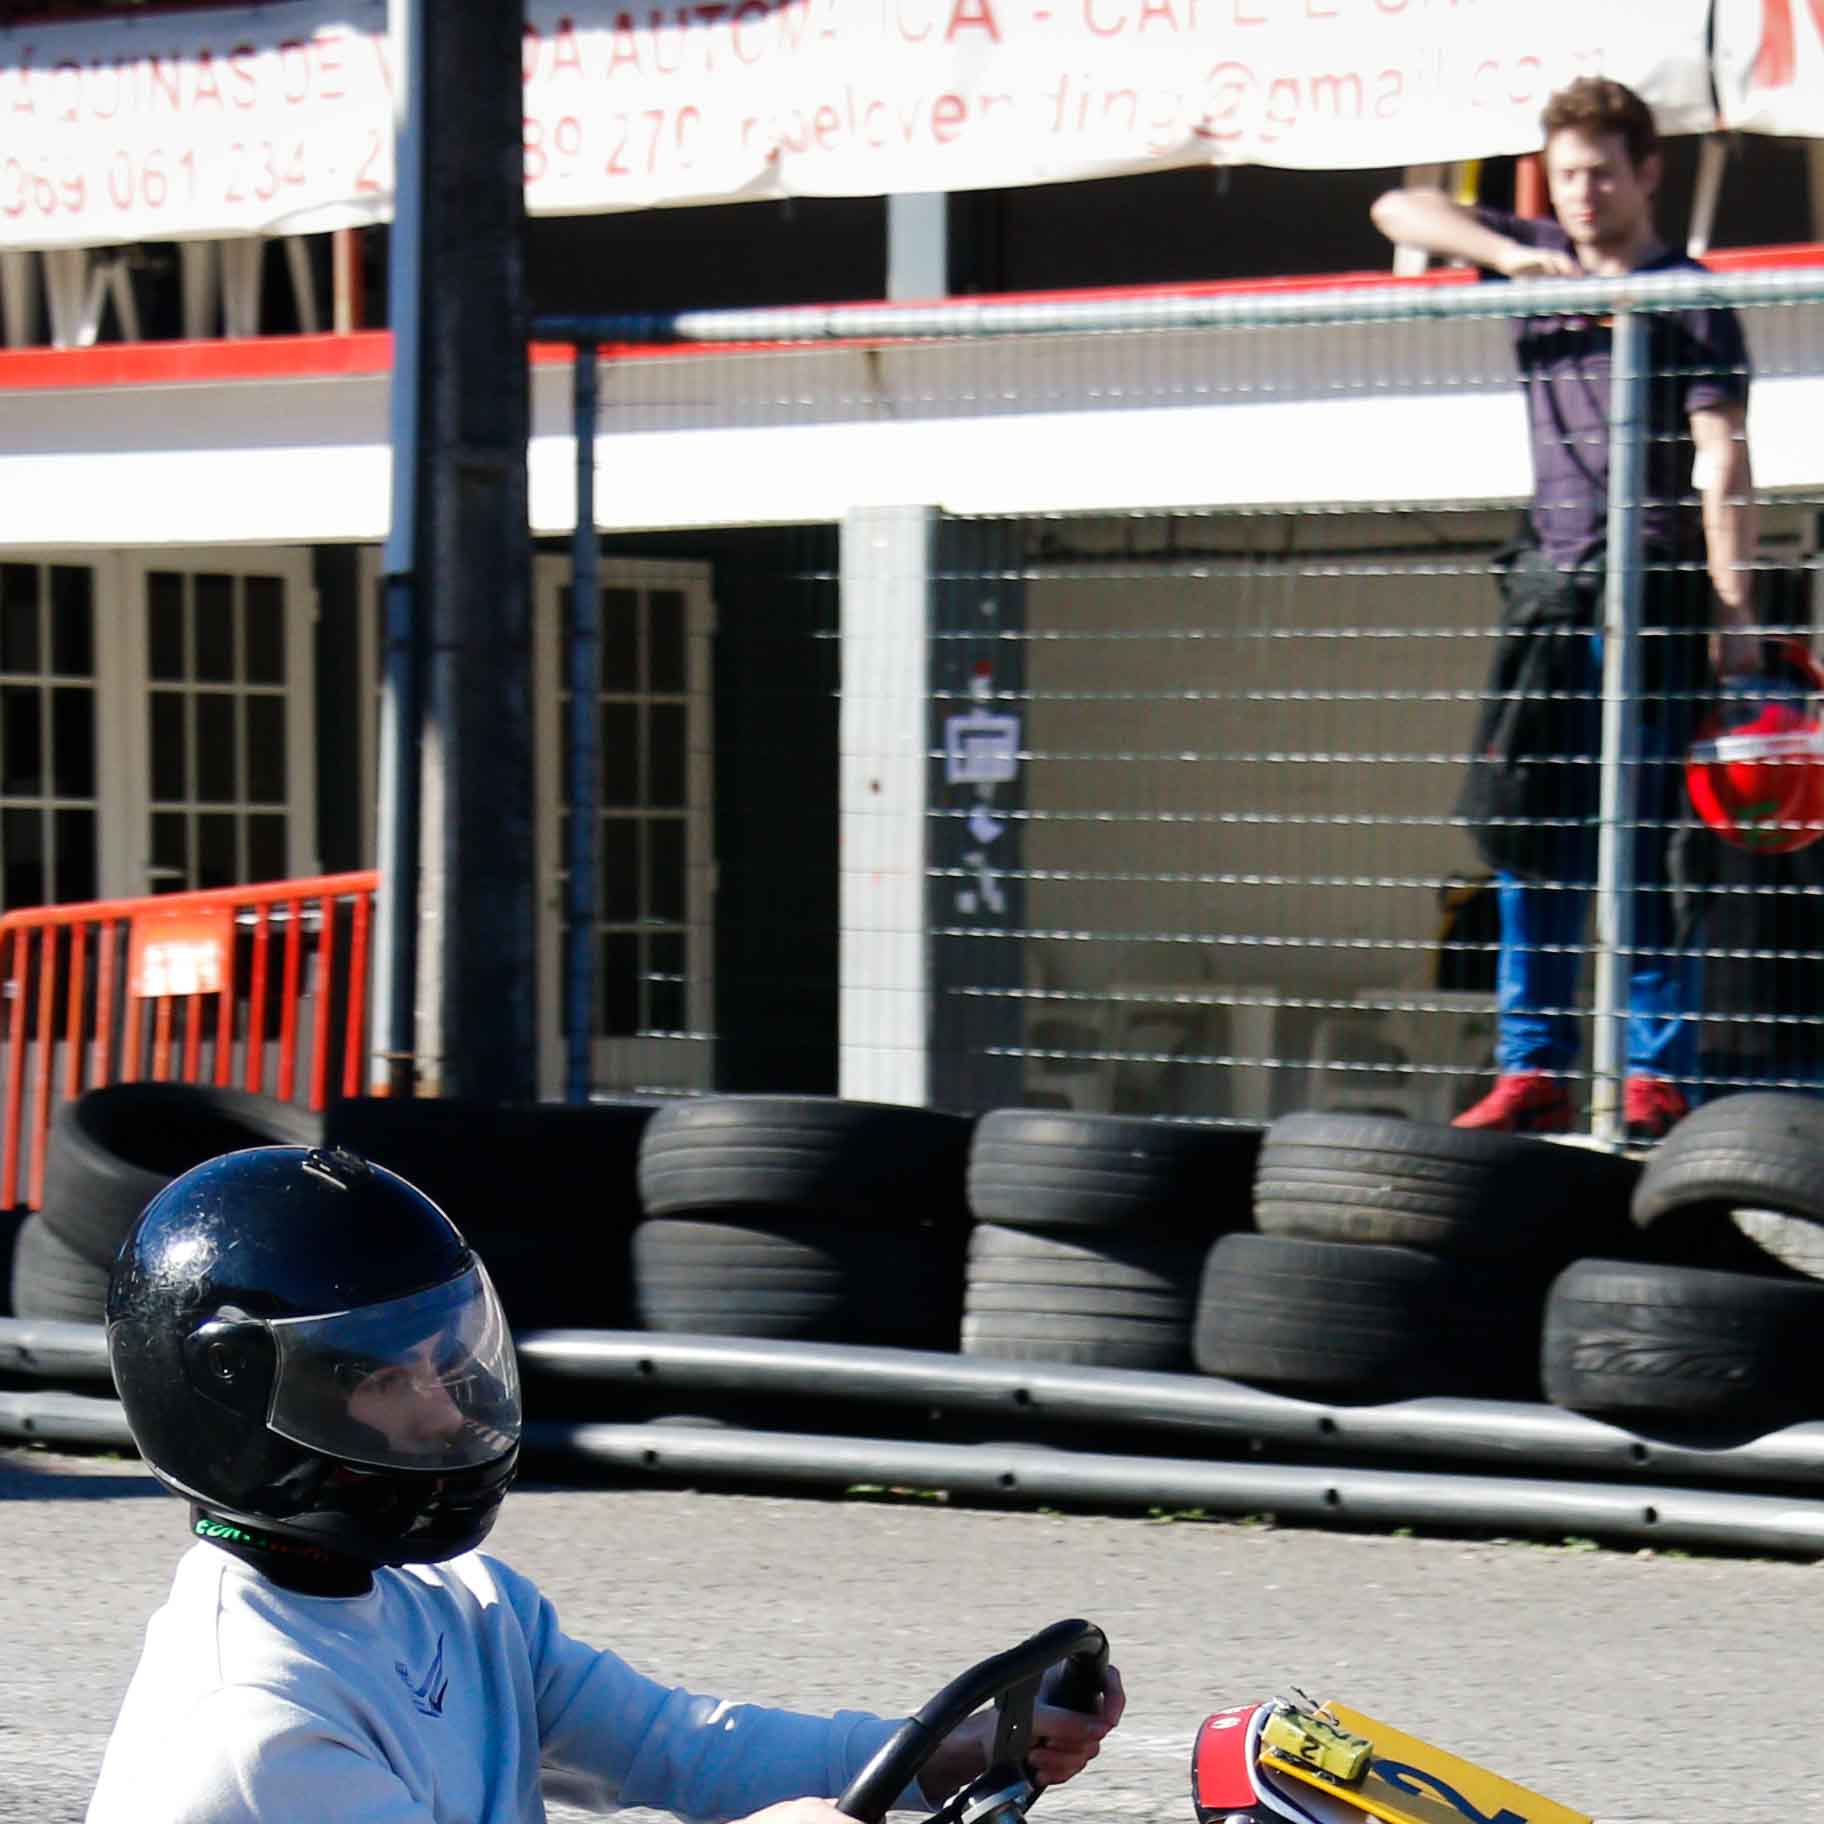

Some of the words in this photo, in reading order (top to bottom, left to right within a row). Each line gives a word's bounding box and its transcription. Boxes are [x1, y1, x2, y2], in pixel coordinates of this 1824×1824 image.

[279, 36, 345, 104] DE
[106, 148, 198, 212] 061
[223, 138, 308, 204] 234
[604, 100, 703, 178] 270
